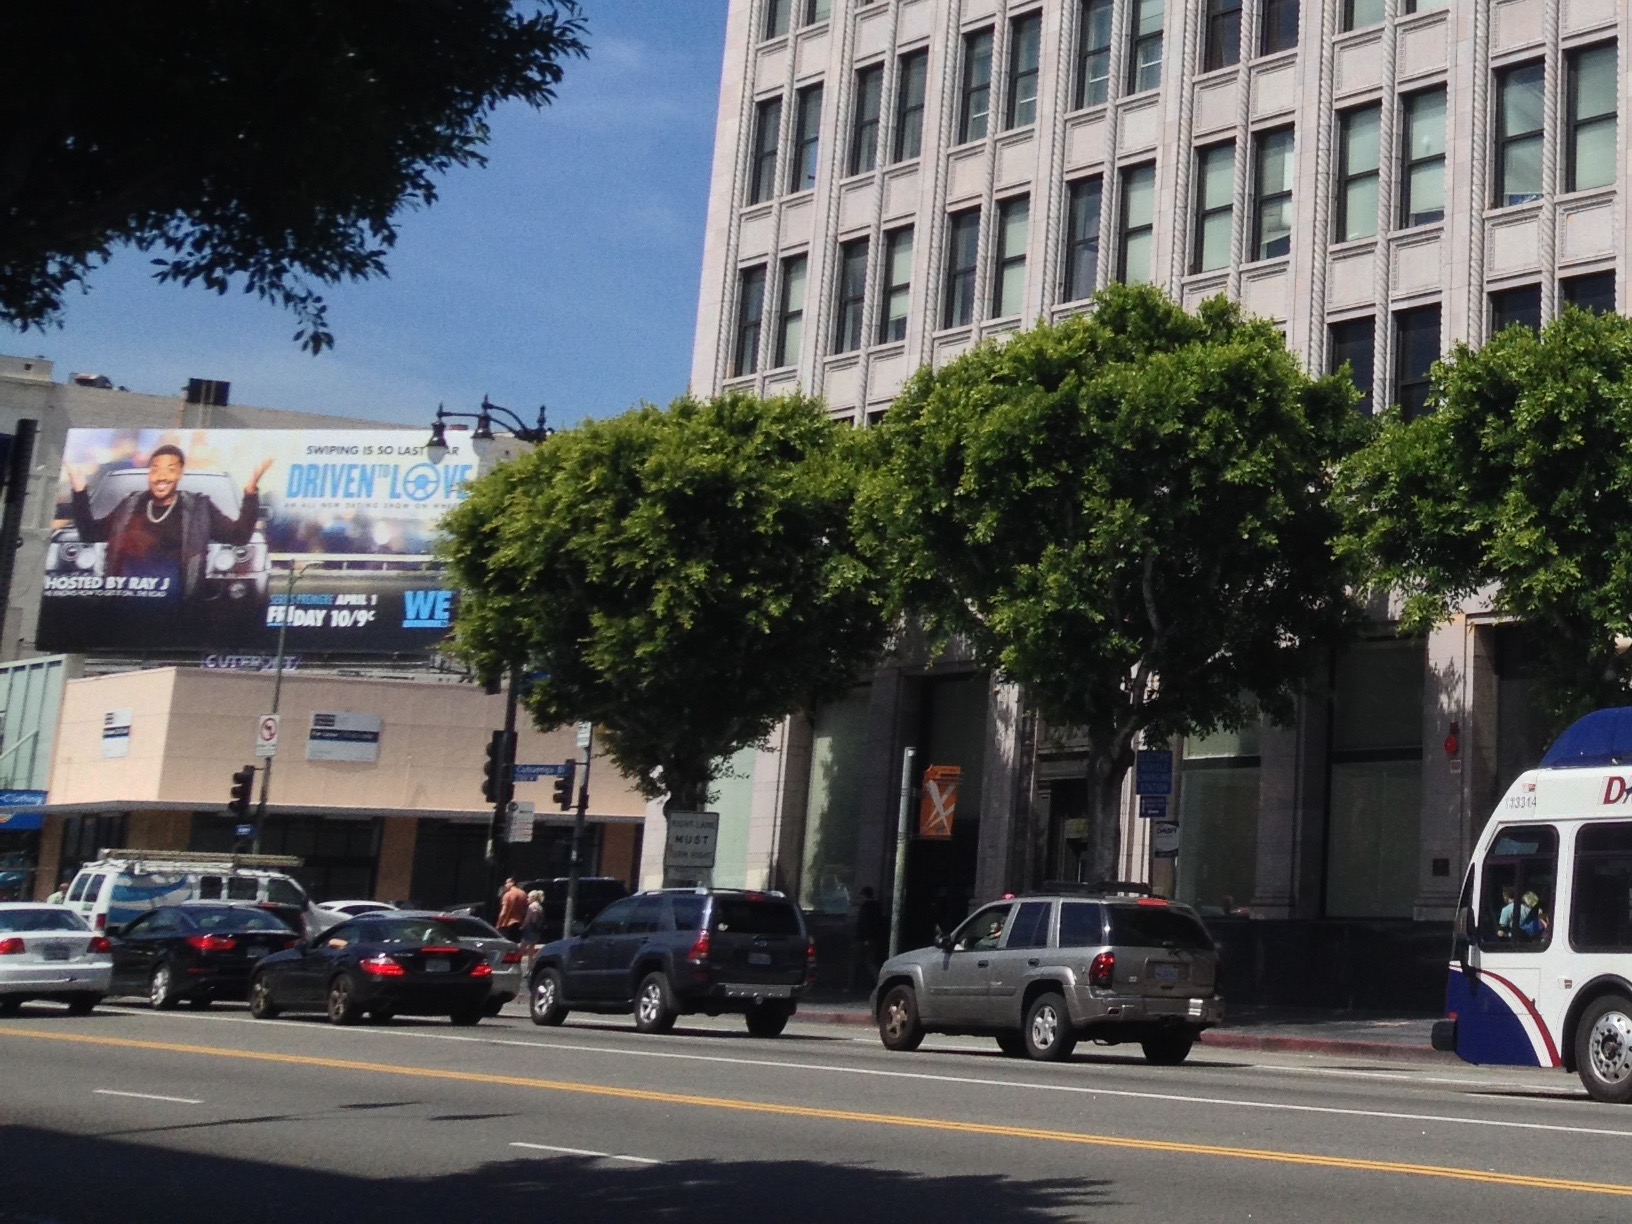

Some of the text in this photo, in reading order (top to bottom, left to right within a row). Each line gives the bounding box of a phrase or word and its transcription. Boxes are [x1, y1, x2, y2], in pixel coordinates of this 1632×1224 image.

[306, 445, 359, 455] SWIPING
[363, 445, 374, 455] IS
[377, 445, 393, 455] SO
[398, 445, 424, 456] LAST
[286, 462, 376, 500] DRIVEN
[389, 462, 474, 502] LOVE
[44, 576, 171, 591] HOSTED BY RAY J
[335, 594, 368, 606] APRIL
[370, 594, 378, 606] 1
[403, 589, 457, 620] WE
[674, 834, 709, 845] MUST
